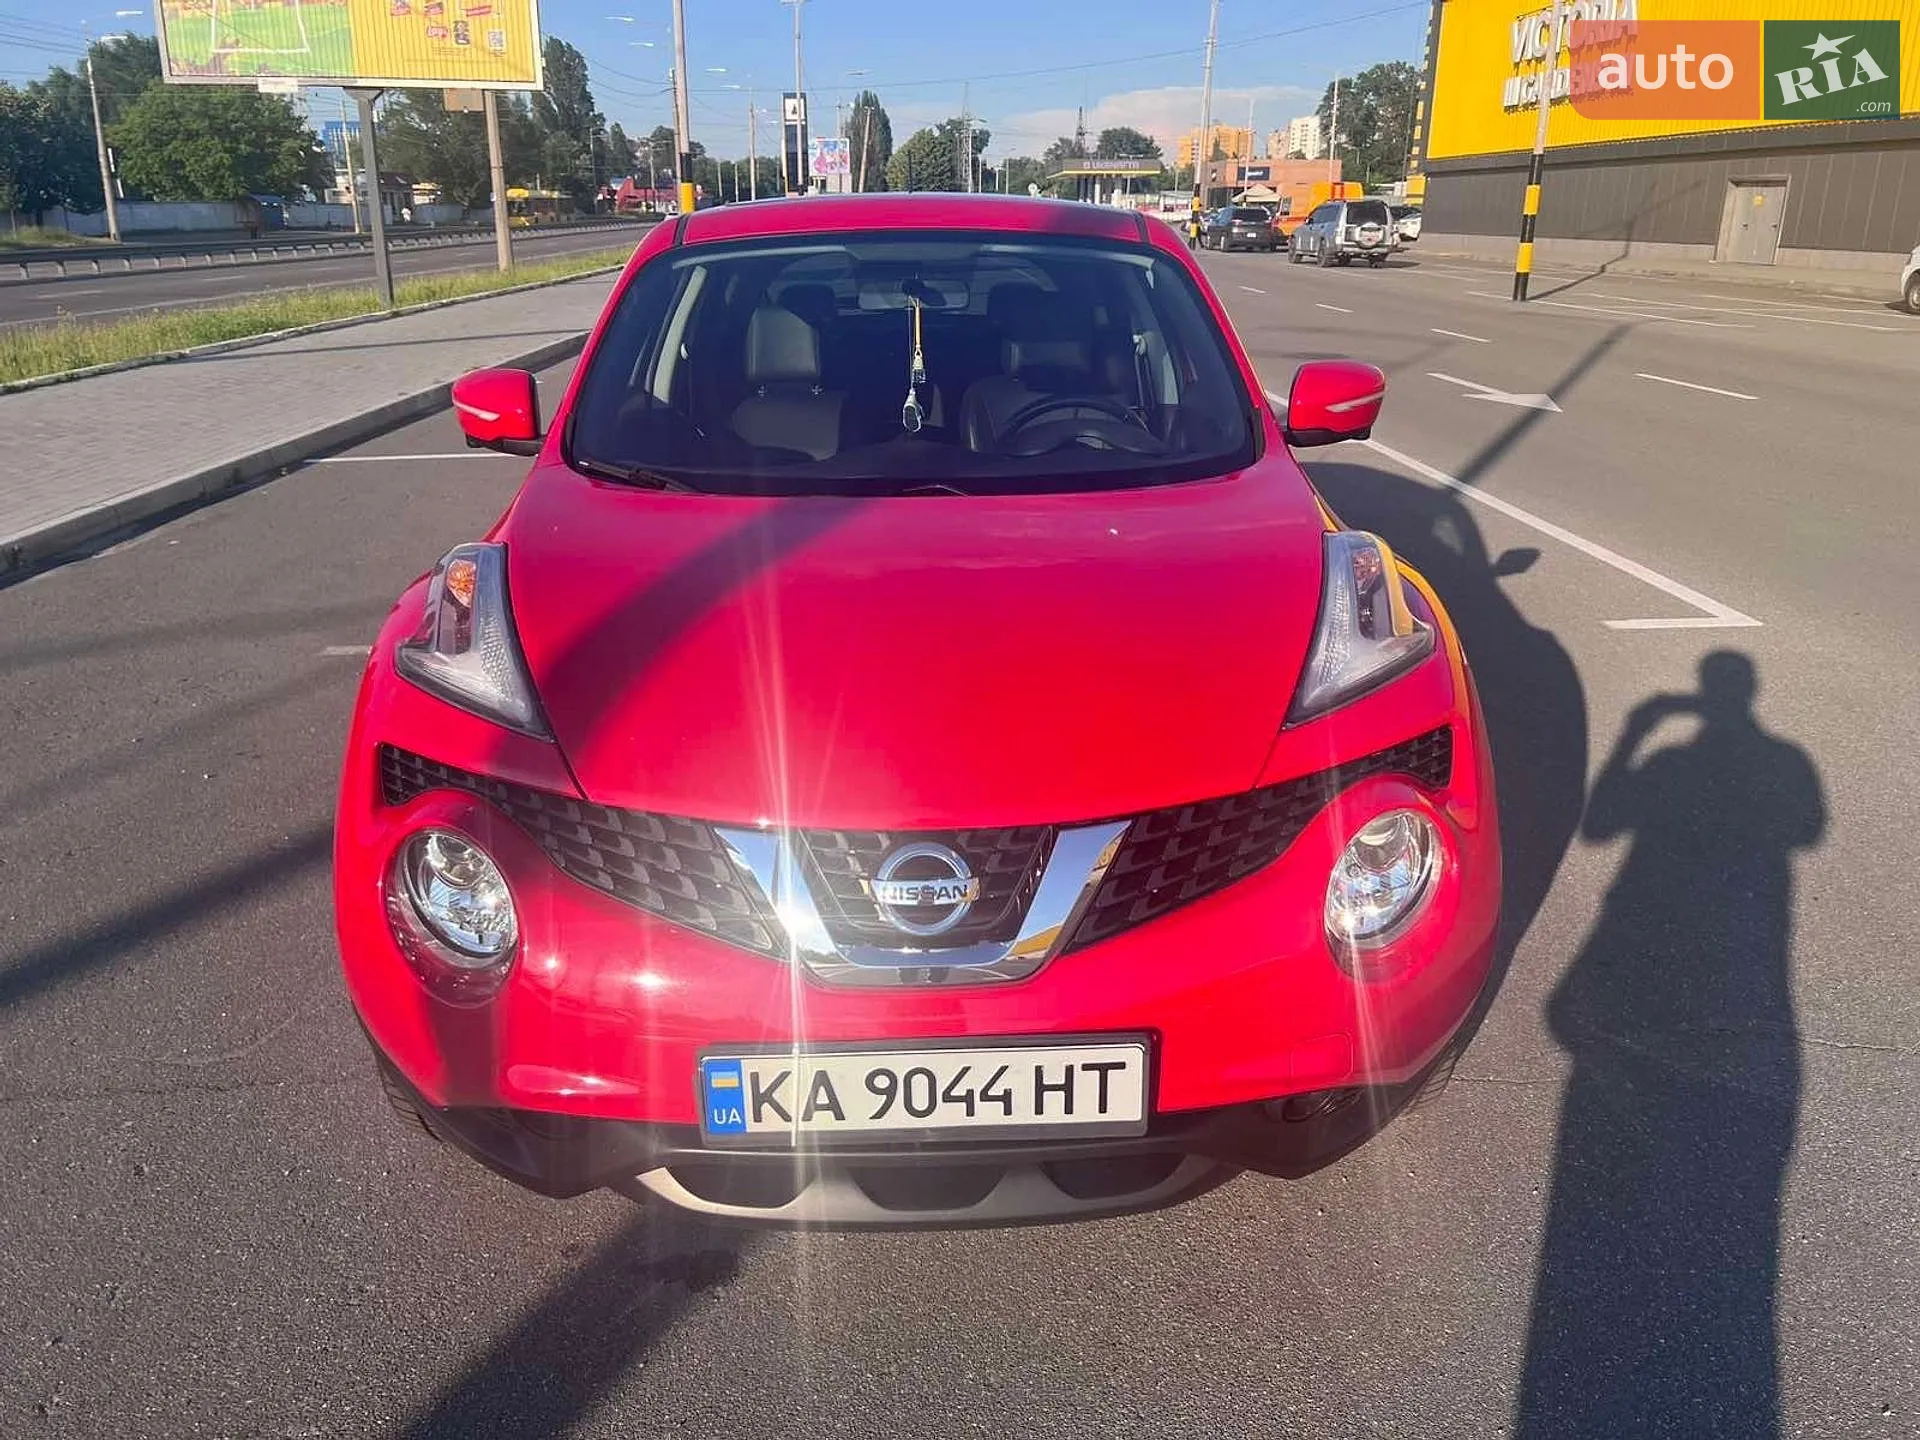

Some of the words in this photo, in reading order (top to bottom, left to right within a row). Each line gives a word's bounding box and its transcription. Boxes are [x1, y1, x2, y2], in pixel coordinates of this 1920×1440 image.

[1512, 0, 1639, 63] VICTORIA
[880, 884, 968, 901] NISSAN
[749, 1069, 846, 1123] KA
[864, 1064, 1013, 1119] 9044
[1034, 1061, 1127, 1116] HT
[713, 1106, 742, 1126] UA
